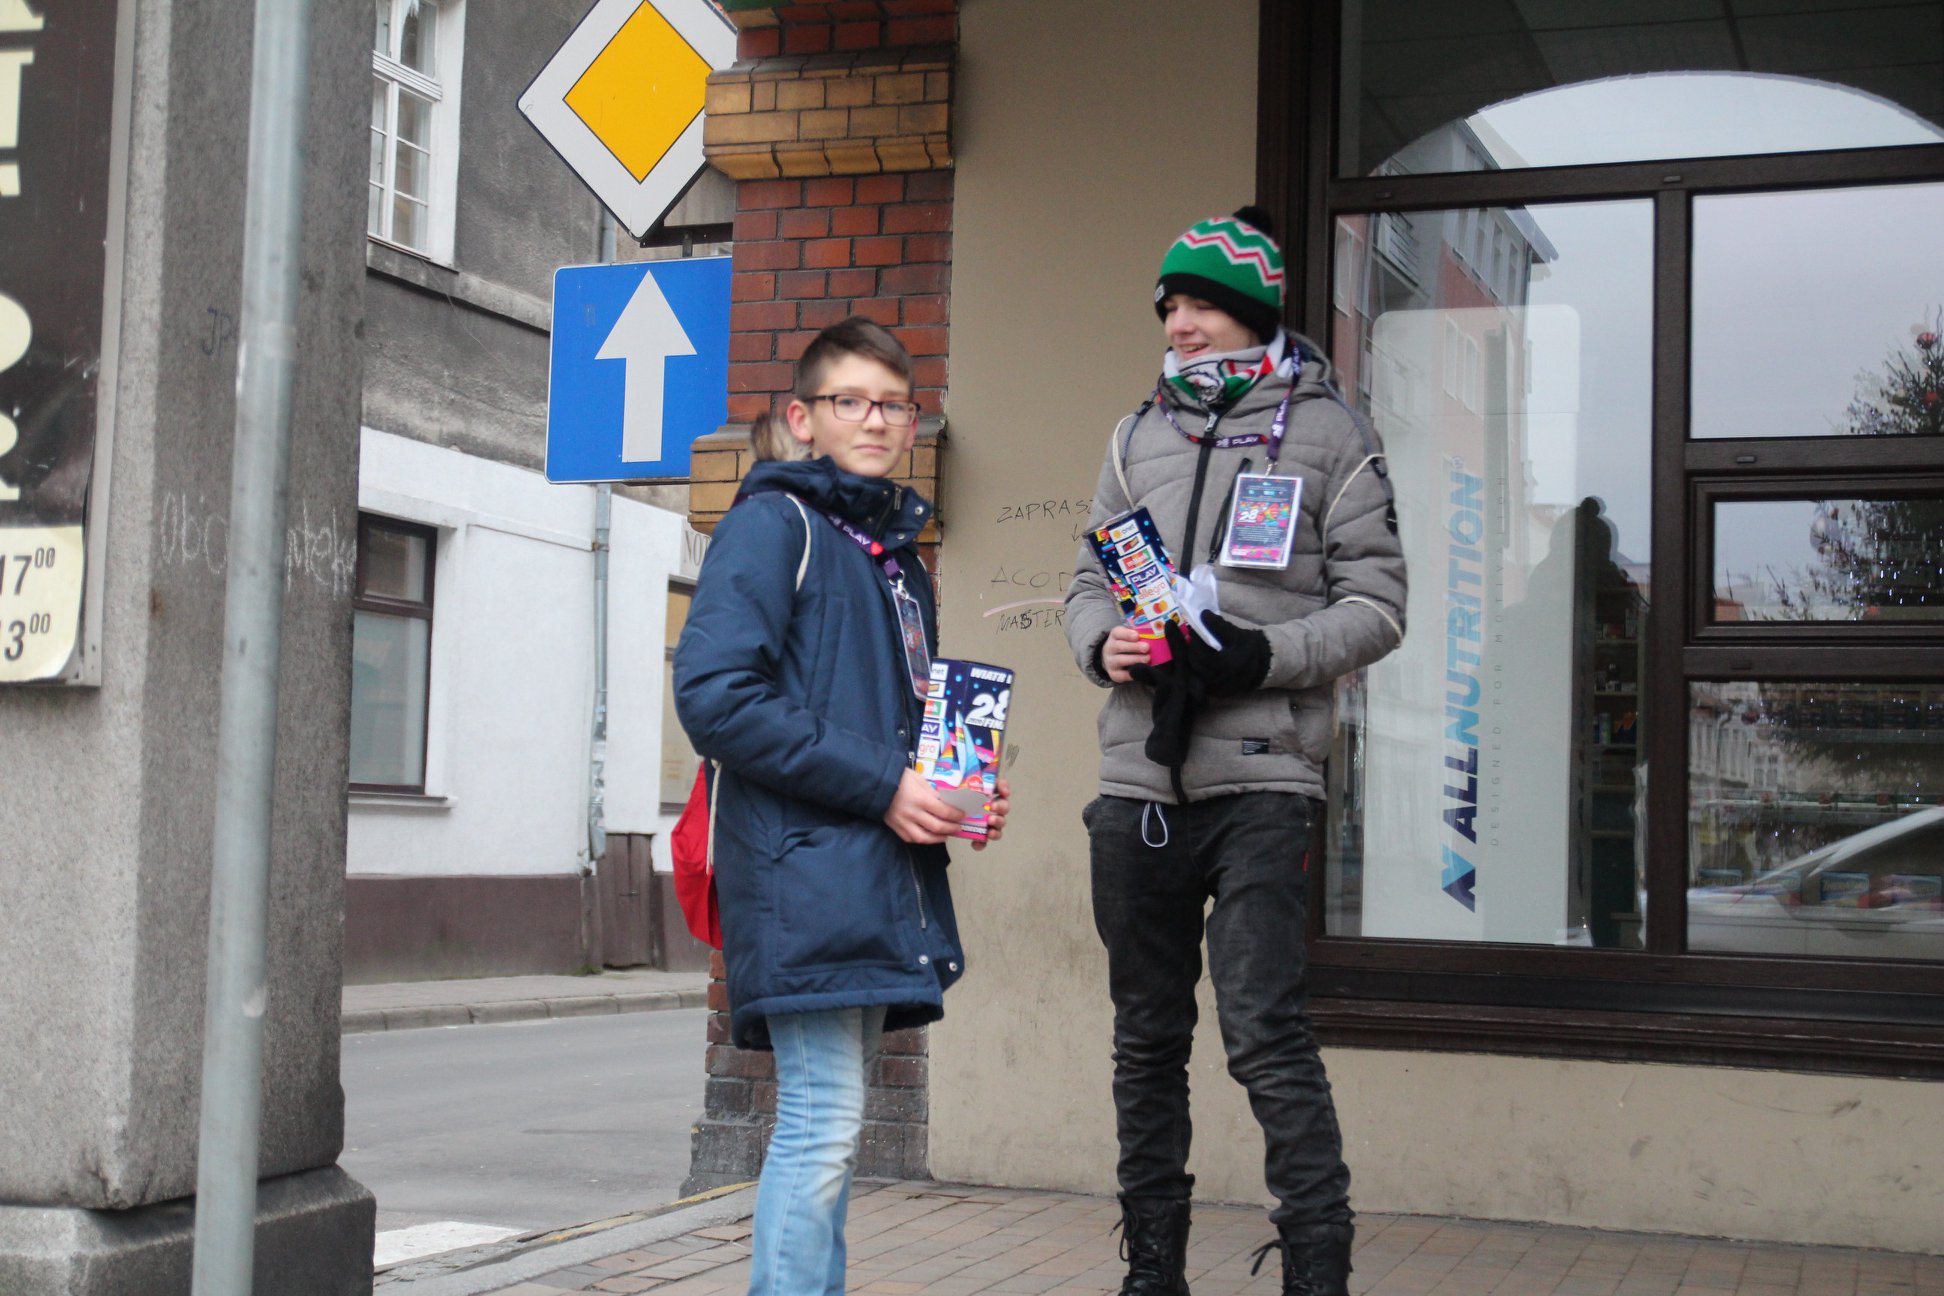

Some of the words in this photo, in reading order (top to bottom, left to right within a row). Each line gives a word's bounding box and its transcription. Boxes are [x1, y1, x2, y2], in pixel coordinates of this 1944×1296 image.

[1232, 436, 1259, 445] PLAY
[1130, 566, 1157, 583] PLAY
[0, 612, 51, 661] 300
[1493, 664, 1502, 705] FOR
